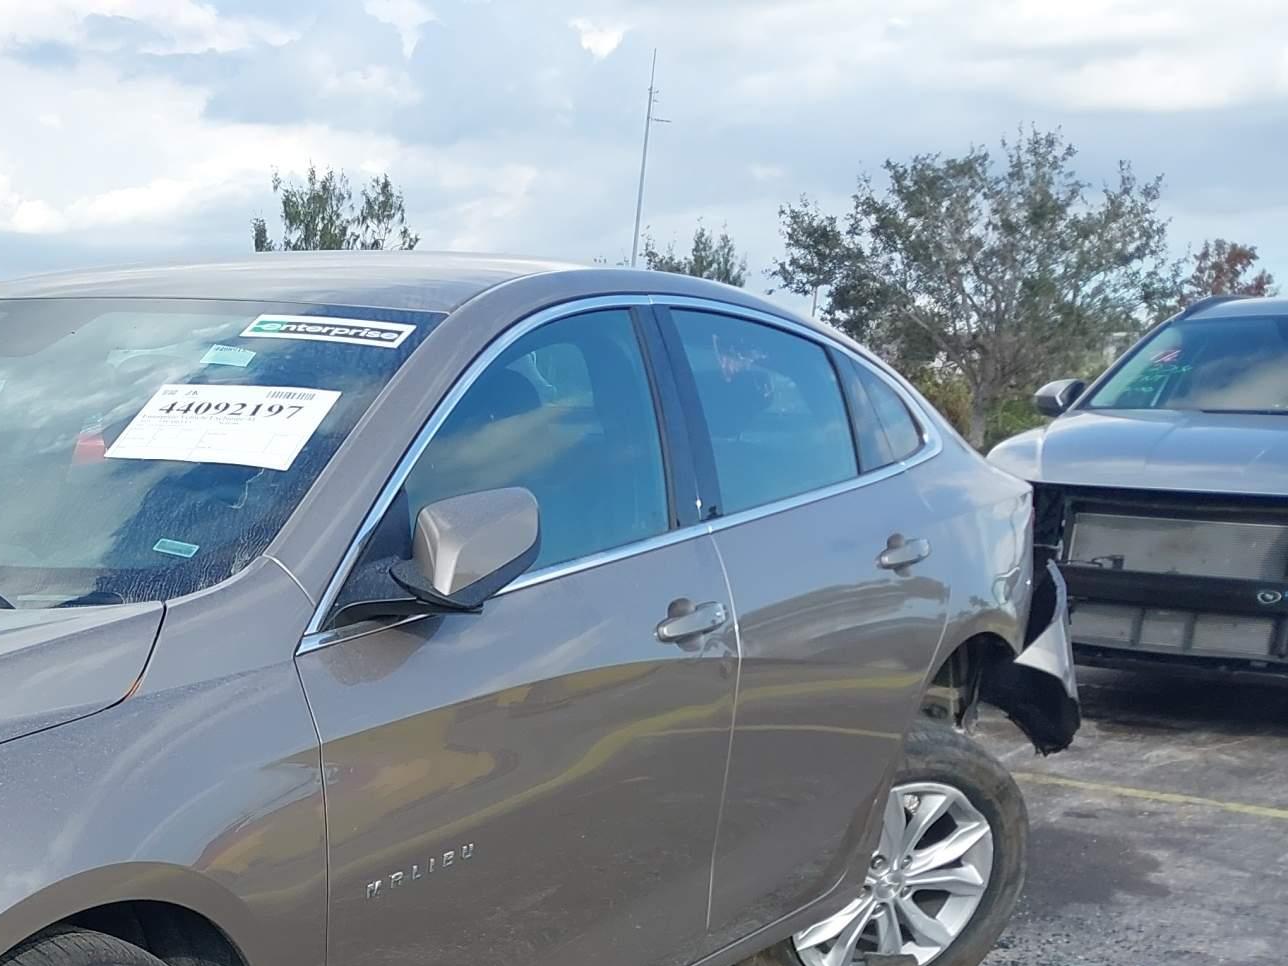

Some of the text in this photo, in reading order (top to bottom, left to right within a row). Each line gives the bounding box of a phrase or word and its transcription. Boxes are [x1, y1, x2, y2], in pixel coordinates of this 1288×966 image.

[260, 320, 400, 342] enterprise
[159, 401, 304, 420] 44092197
[366, 842, 474, 899] MALIBU
